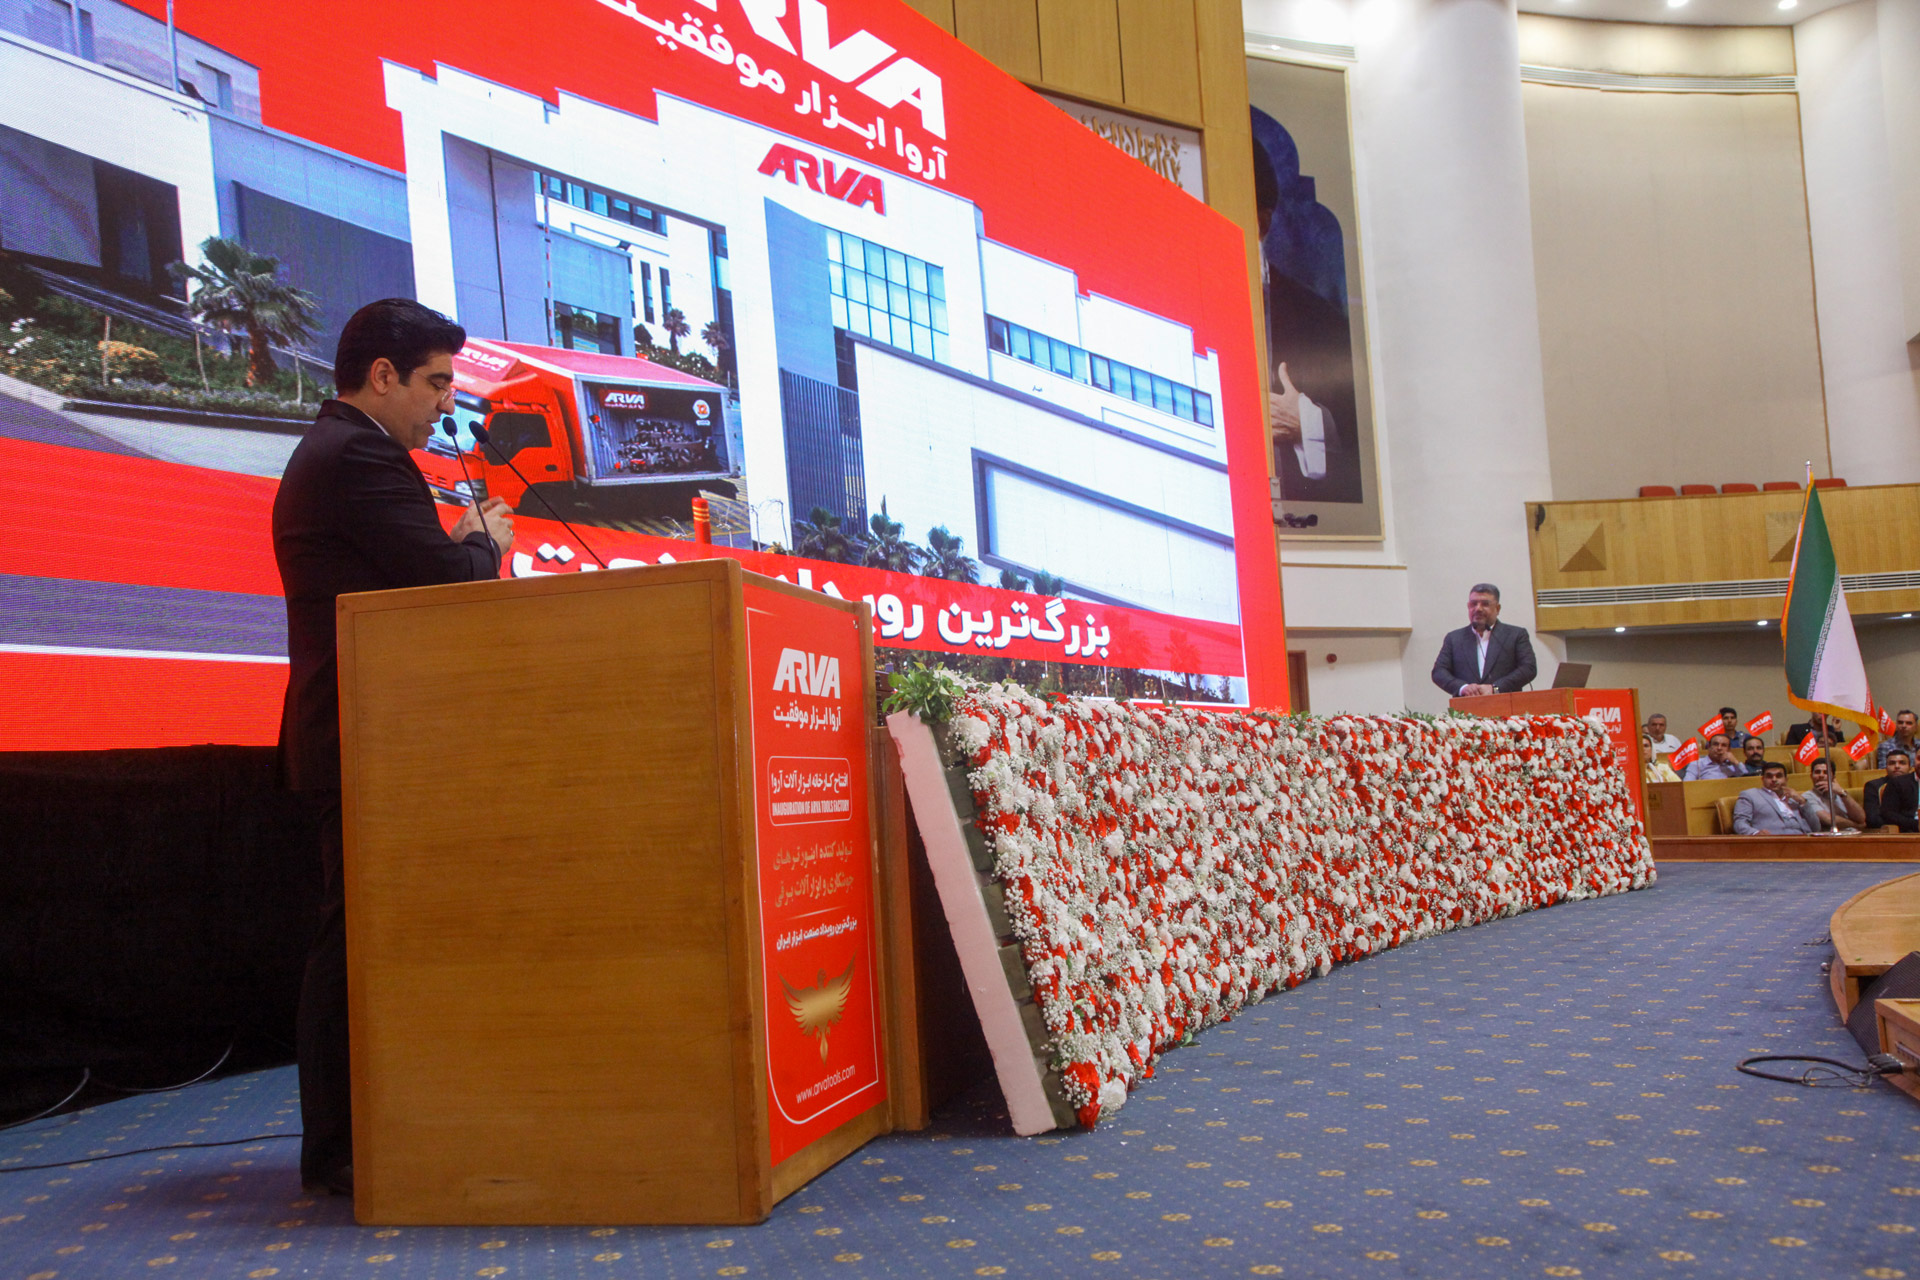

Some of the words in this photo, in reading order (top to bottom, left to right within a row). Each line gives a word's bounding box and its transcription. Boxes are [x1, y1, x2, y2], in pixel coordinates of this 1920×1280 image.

[794, 80, 886, 151] ابزار
[895, 126, 948, 181] آروا
[757, 142, 887, 217] ARVA
[604, 391, 645, 405] ARVA
[772, 647, 841, 699] ARVA
[773, 700, 809, 729] موفقیت
[809, 705, 829, 730] ابزار
[829, 706, 842, 732] آروا
[1750, 714, 1772, 731] ARVA
[795, 1064, 856, 1104] www.arvatools.com
